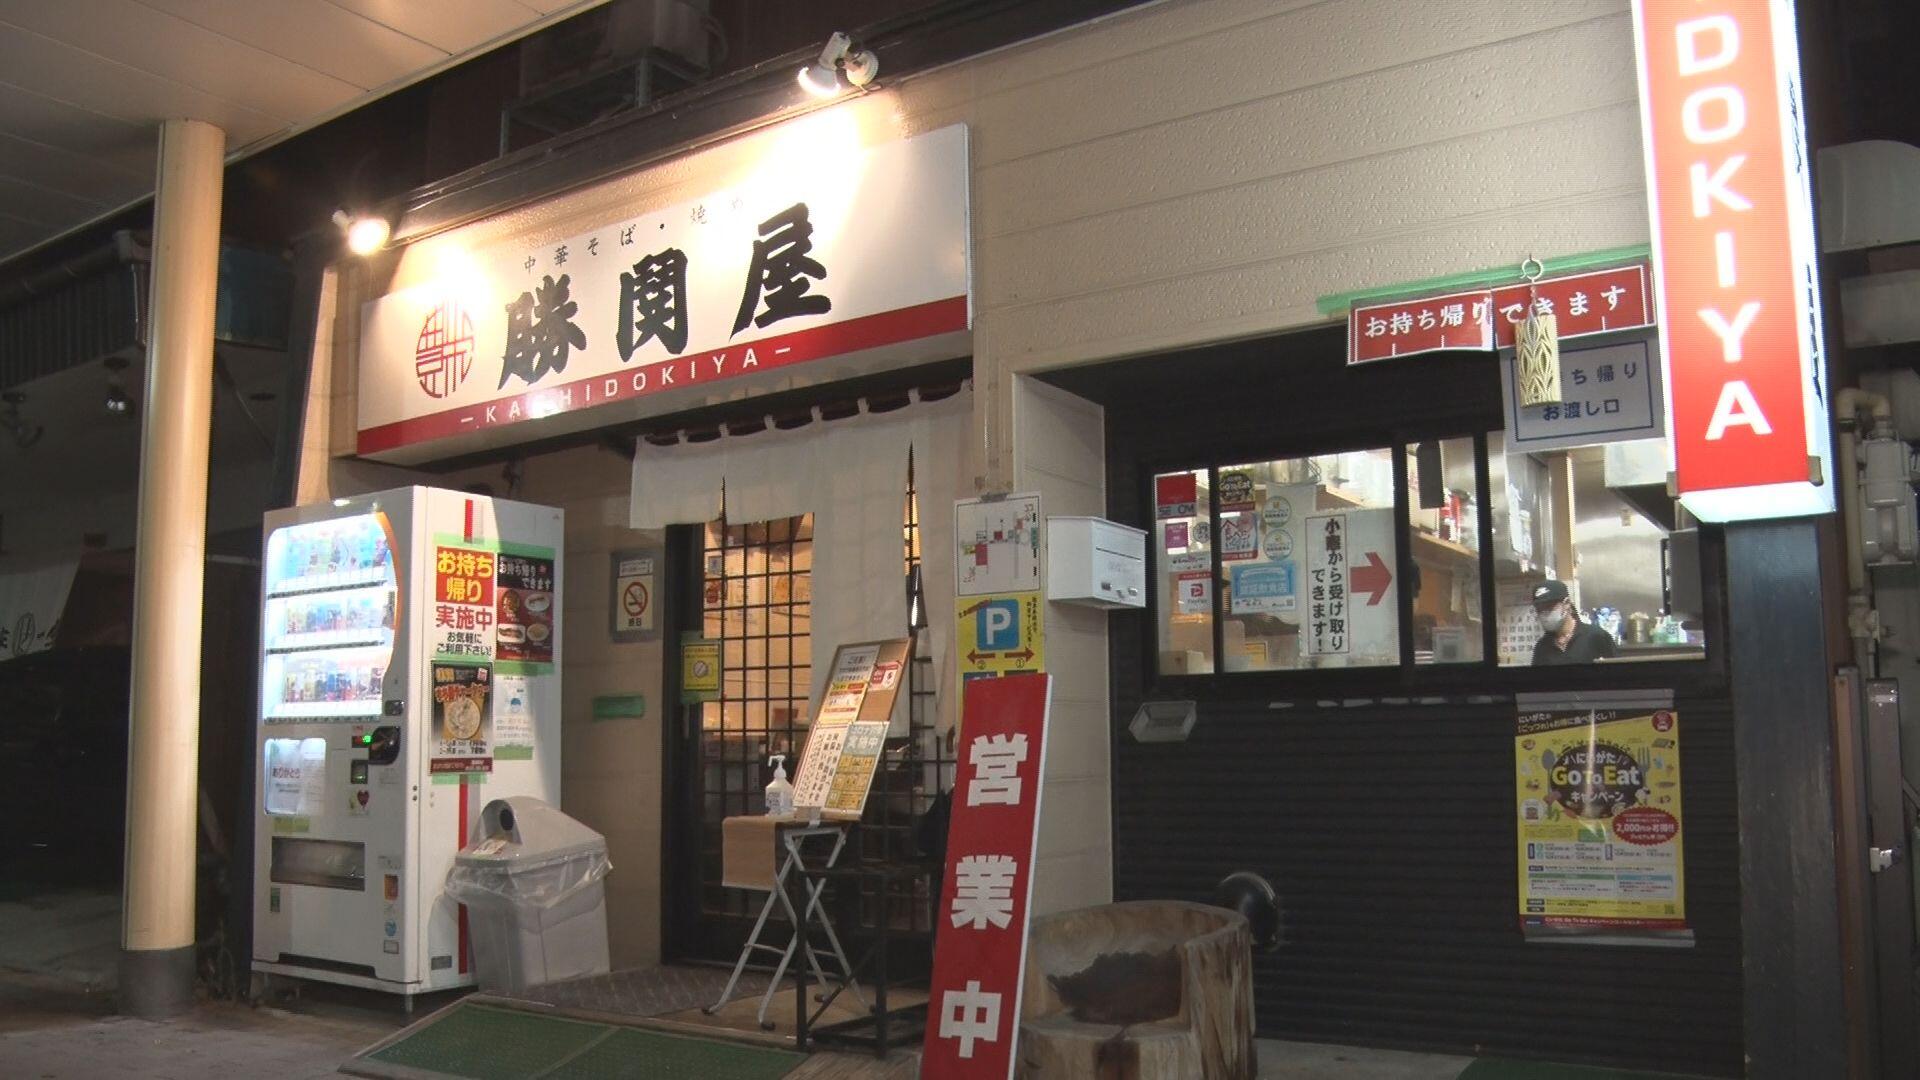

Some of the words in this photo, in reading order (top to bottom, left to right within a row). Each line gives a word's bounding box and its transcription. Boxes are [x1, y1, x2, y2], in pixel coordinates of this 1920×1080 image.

[1674, 14, 1774, 441] DOKIYA
[1365, 285, 1626, 338] お持ち帰りできます
[485, 347, 759, 424] KAHIDOKIYA
[1543, 398, 1621, 421] お渡し口
[437, 550, 493, 578] お持ち
[446, 576, 482, 603] 帰り
[436, 605, 493, 631] 実施中
[1311, 568, 1327, 652] できます！
[447, 631, 483, 644] お気軽に
[986, 607, 1012, 645] P
[1552, 766, 1582, 786] Go
[1604, 764, 1640, 786] Eat
[1571, 790, 1624, 802] キャンペーン
[938, 732, 1029, 1059] 営業中
